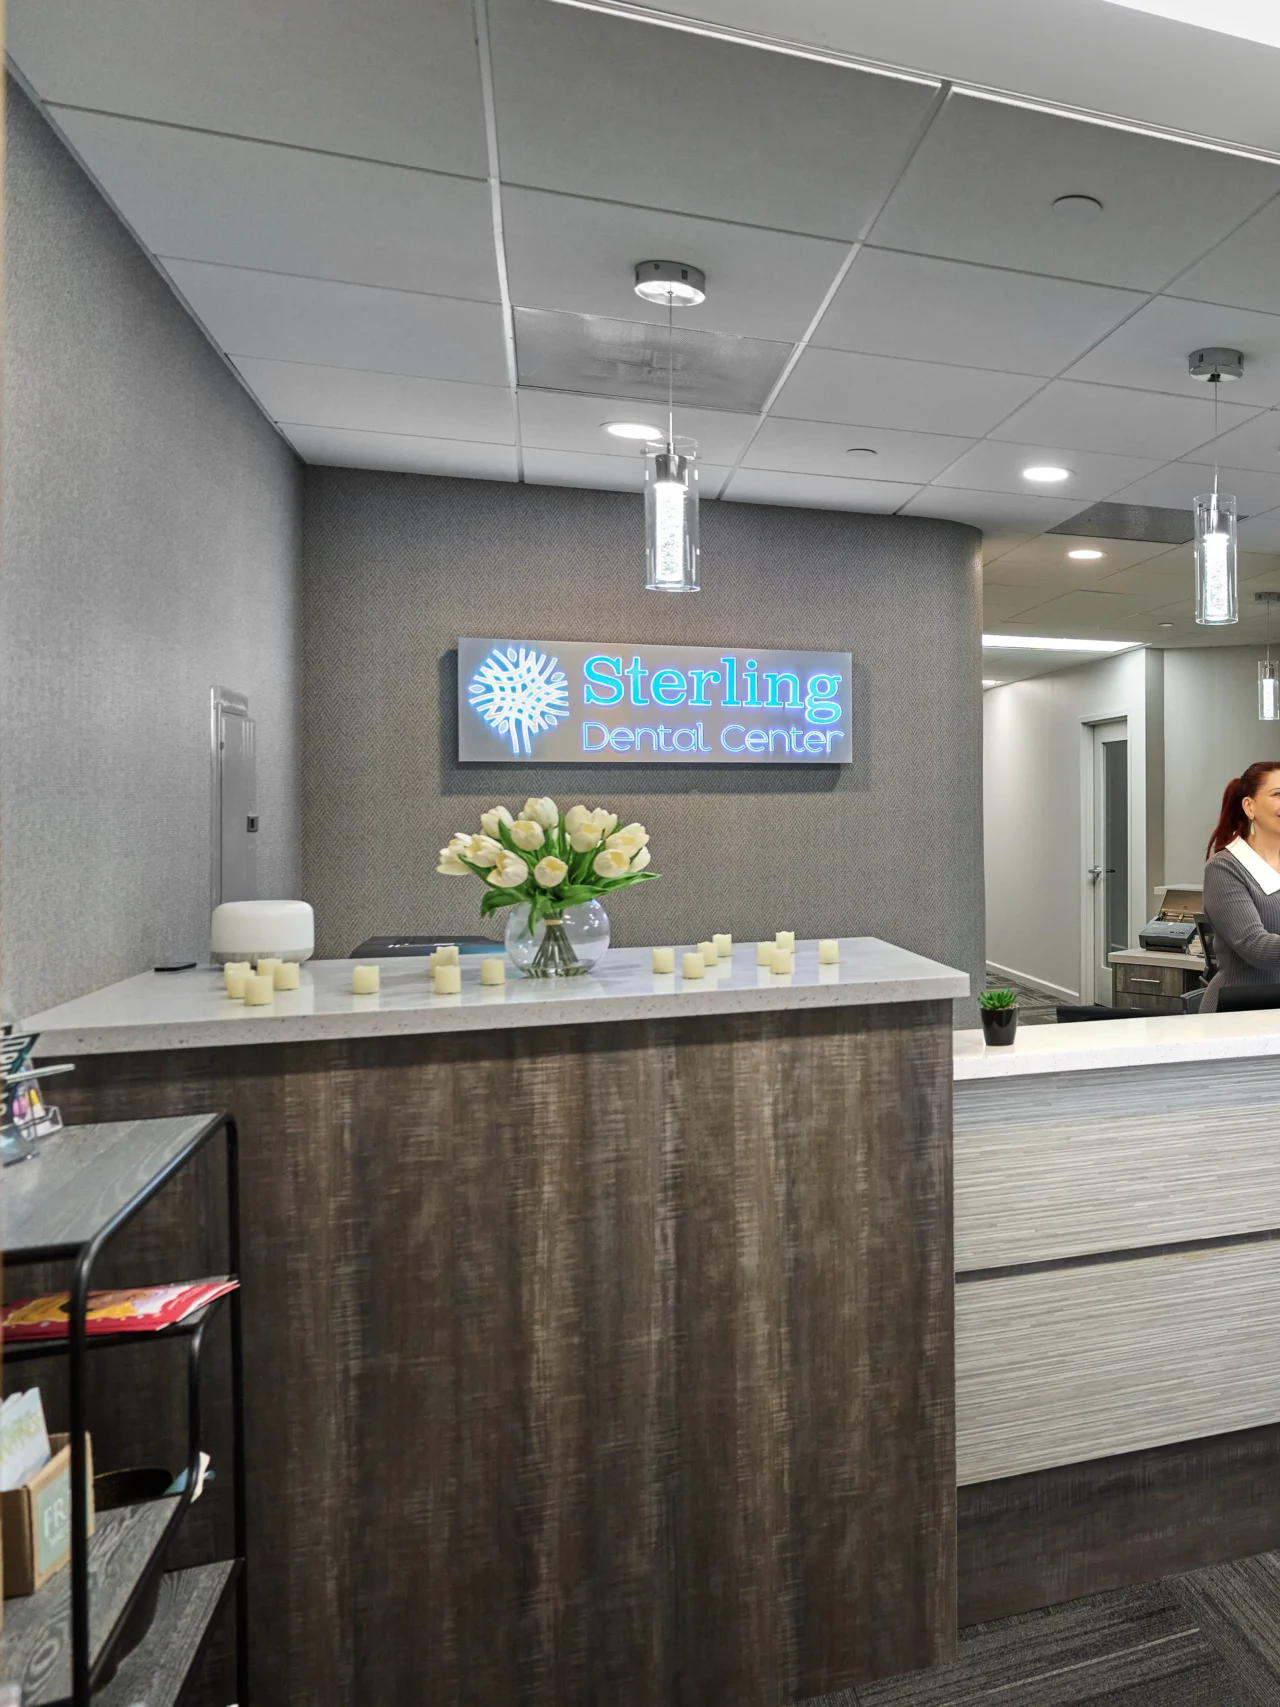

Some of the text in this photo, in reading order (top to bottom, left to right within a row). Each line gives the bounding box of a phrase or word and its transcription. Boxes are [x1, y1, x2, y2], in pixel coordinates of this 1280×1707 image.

[583, 655, 842, 724] Sterling
[583, 722, 845, 753] Dental Center
